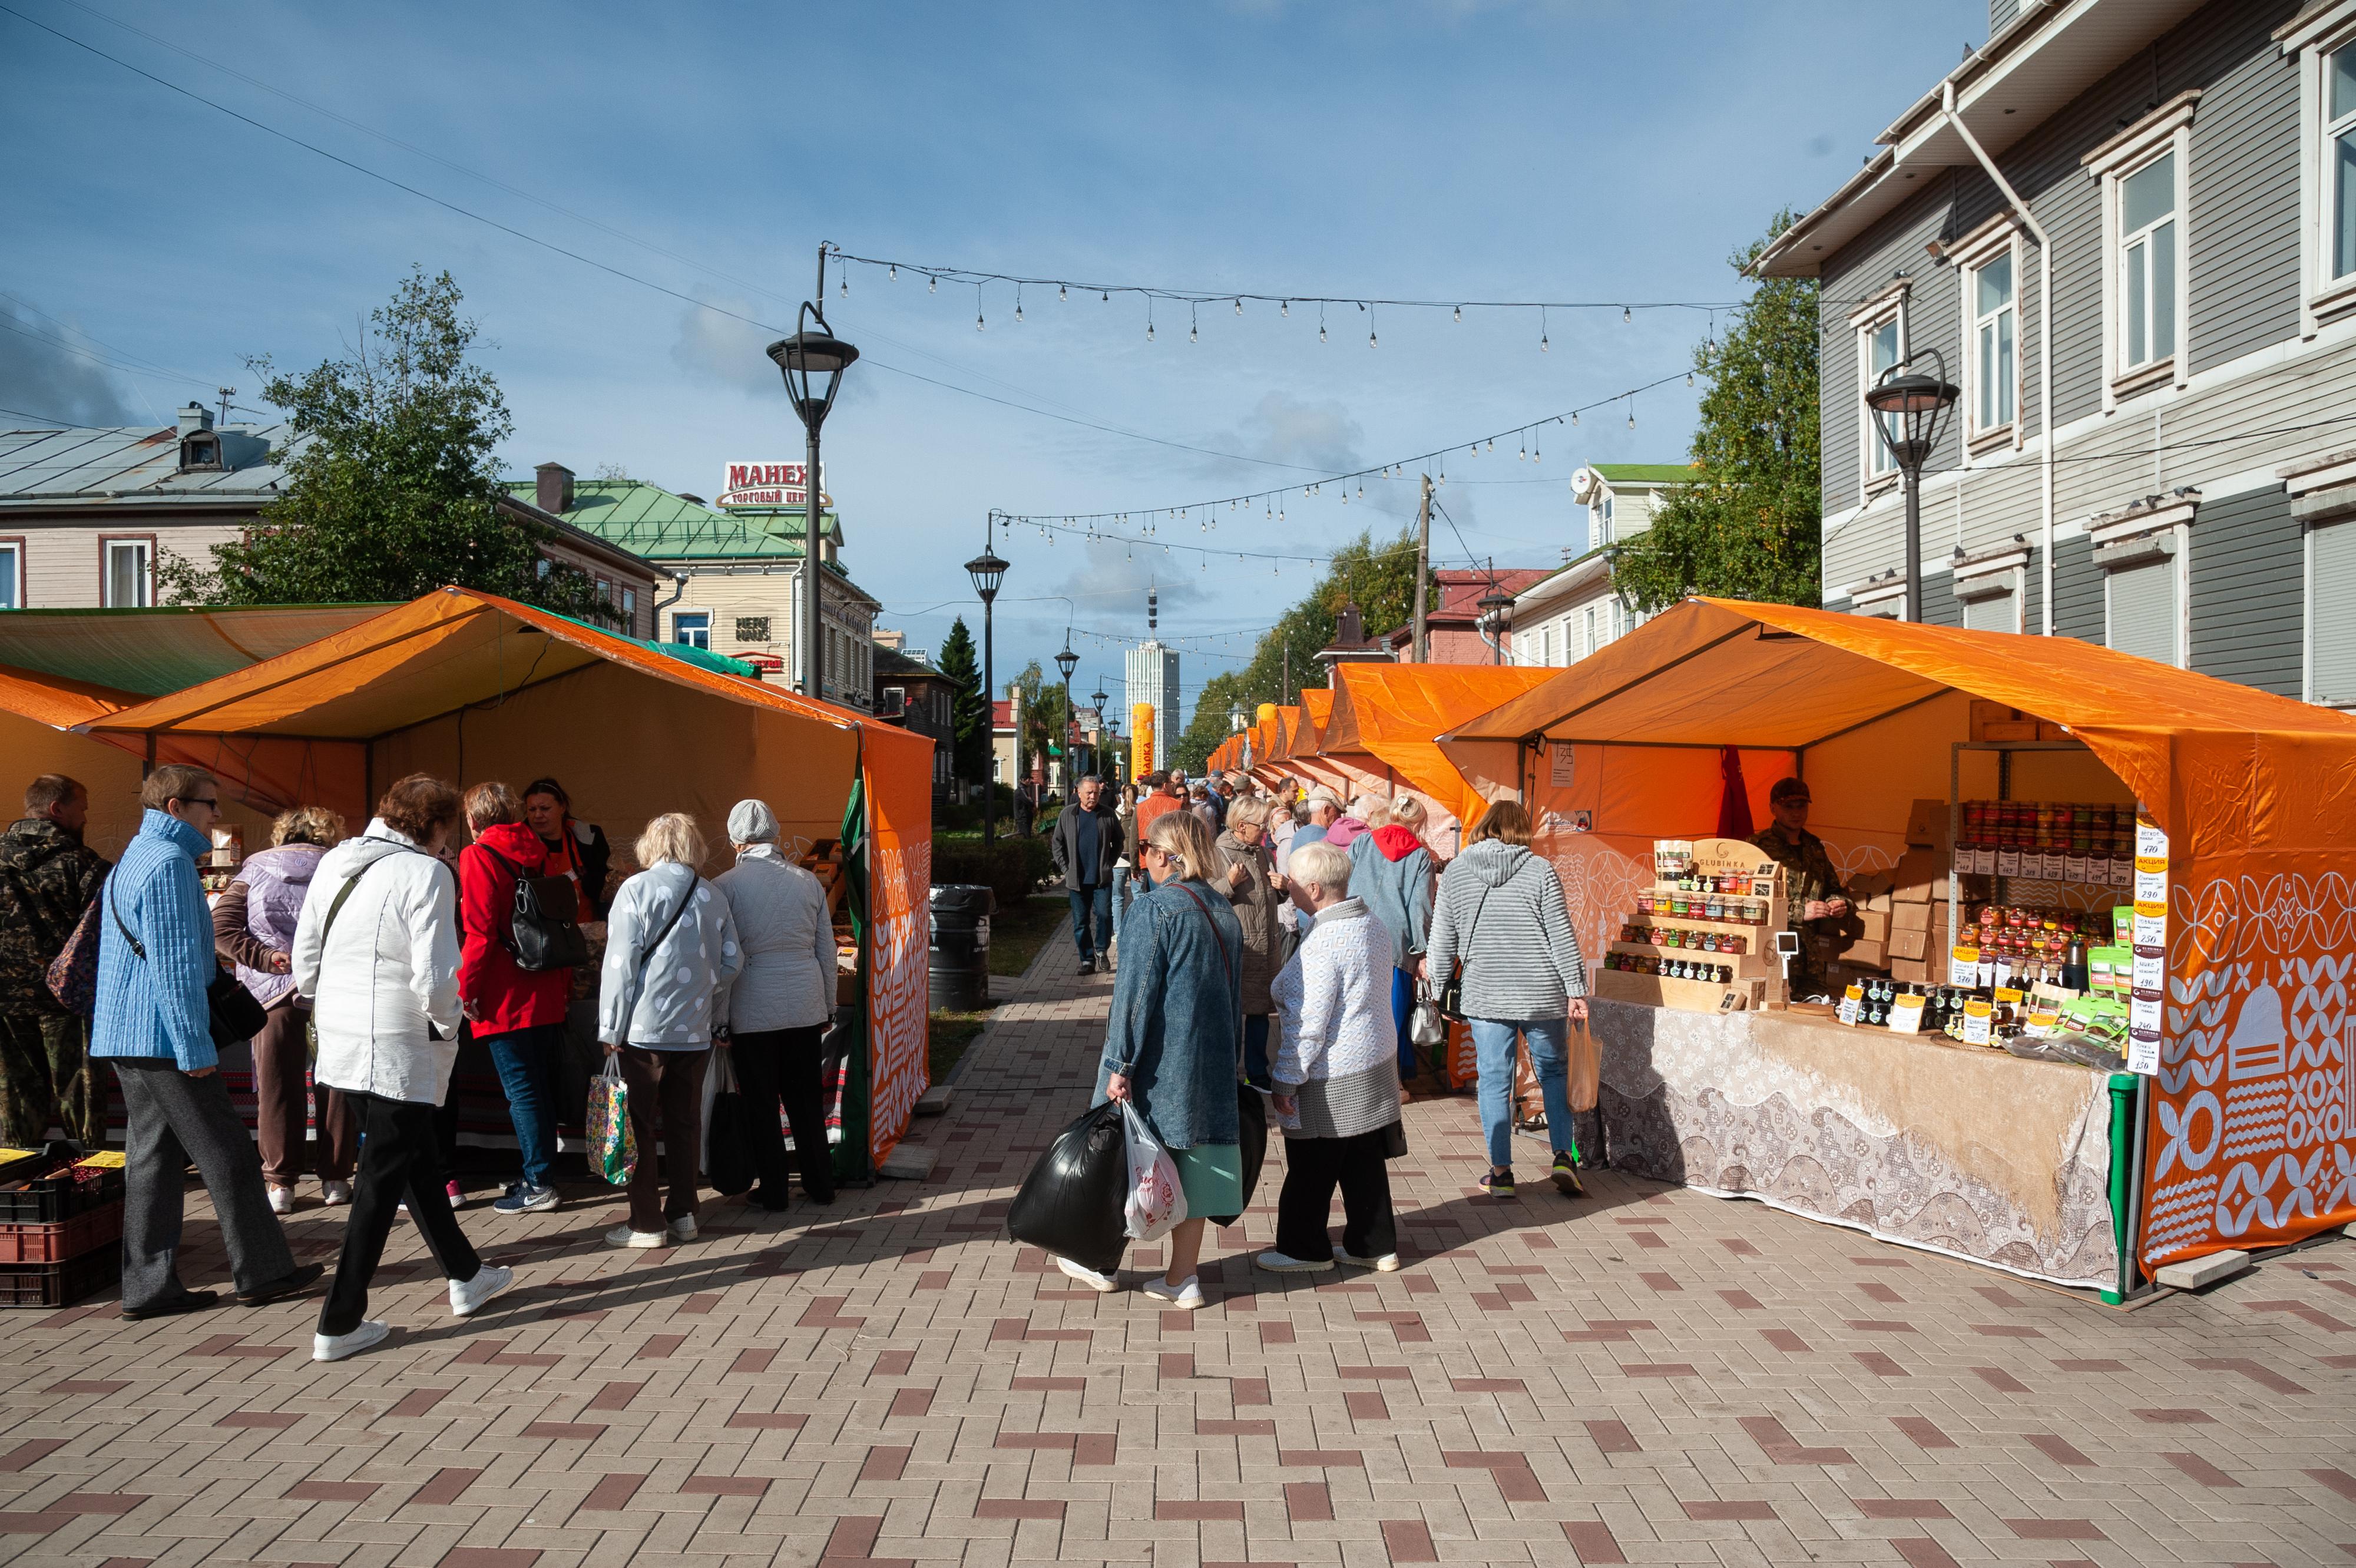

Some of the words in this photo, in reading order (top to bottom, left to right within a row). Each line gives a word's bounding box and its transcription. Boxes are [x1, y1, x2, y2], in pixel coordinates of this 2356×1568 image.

[732, 489, 782, 503] ТОРГОВЫЙ
[786, 492, 806, 502] ЦЕН
[2144, 845, 2158, 854] 170
[1699, 859, 1745, 868] GLUBINKA
[2140, 935, 2156, 944] 250
[1969, 1031, 1985, 1041] 370
[2135, 1061, 2149, 1070] 150
